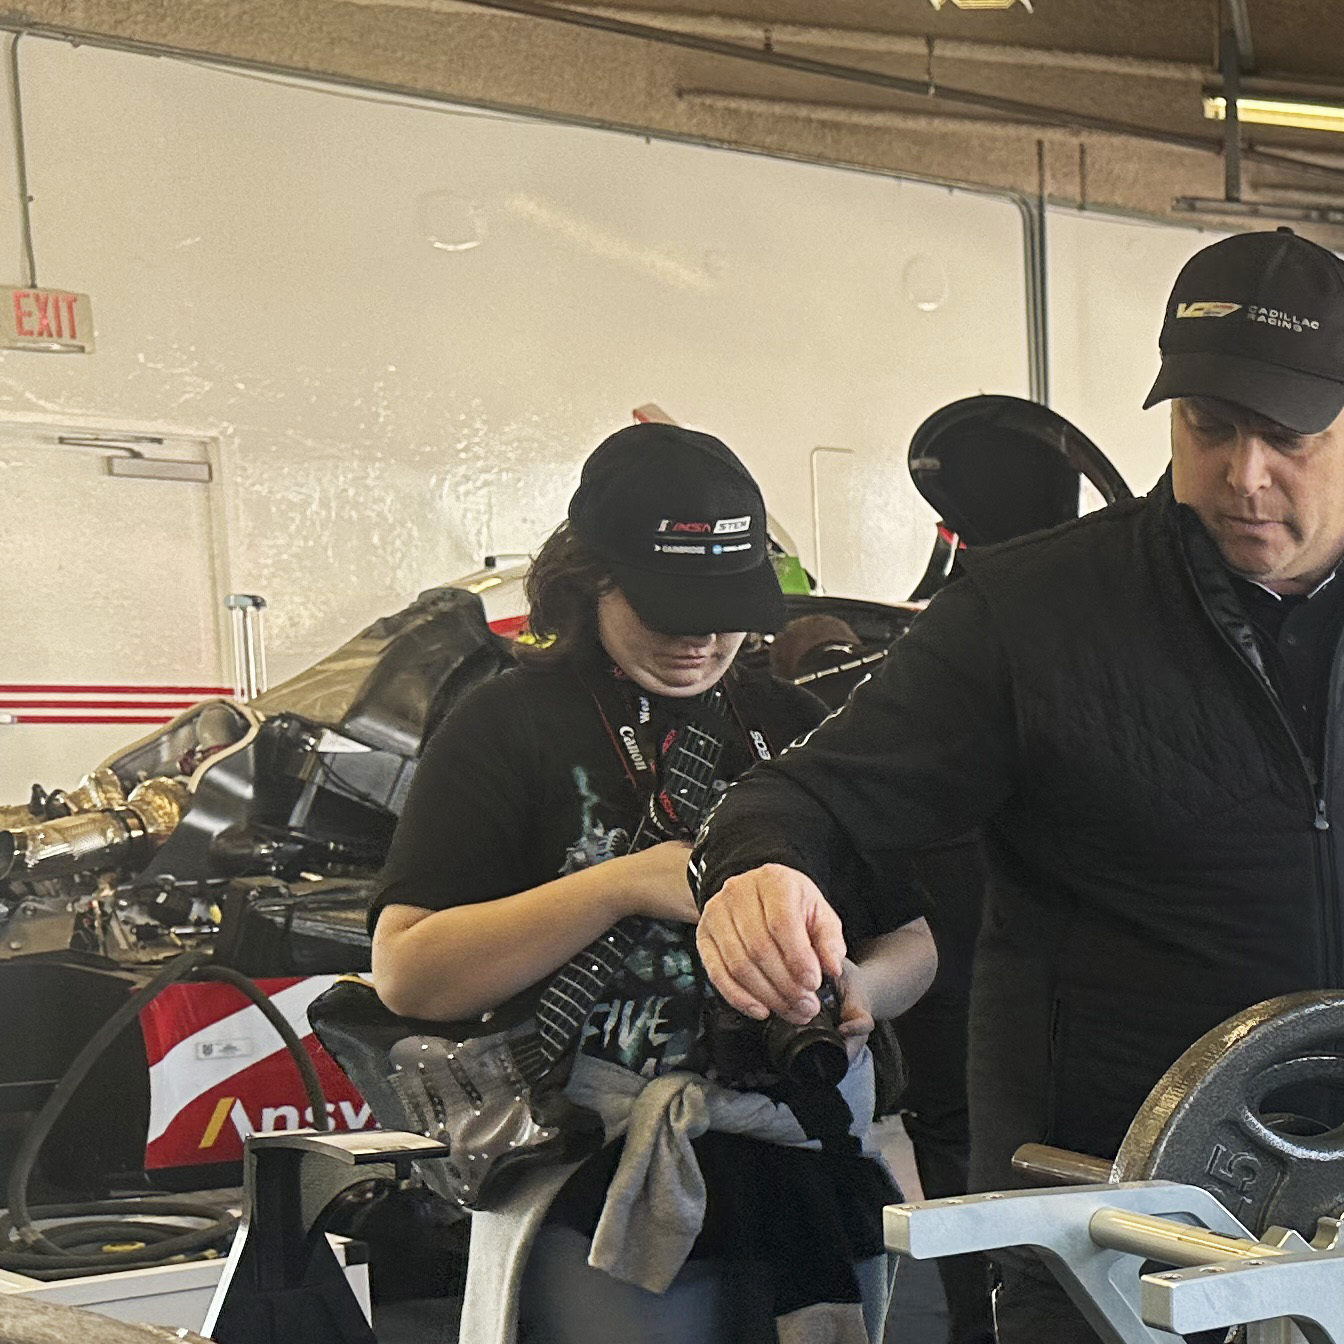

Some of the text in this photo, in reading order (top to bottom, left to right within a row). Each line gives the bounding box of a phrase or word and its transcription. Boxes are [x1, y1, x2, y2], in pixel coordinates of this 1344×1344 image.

[12, 291, 78, 340] EXIT
[1247, 314, 1303, 333] RACING
[1248, 305, 1320, 330] CADILLAC
[719, 521, 748, 531] STEM
[619, 725, 648, 771] Canon
[580, 995, 675, 1052] FIVE
[198, 1097, 380, 1149] Any
